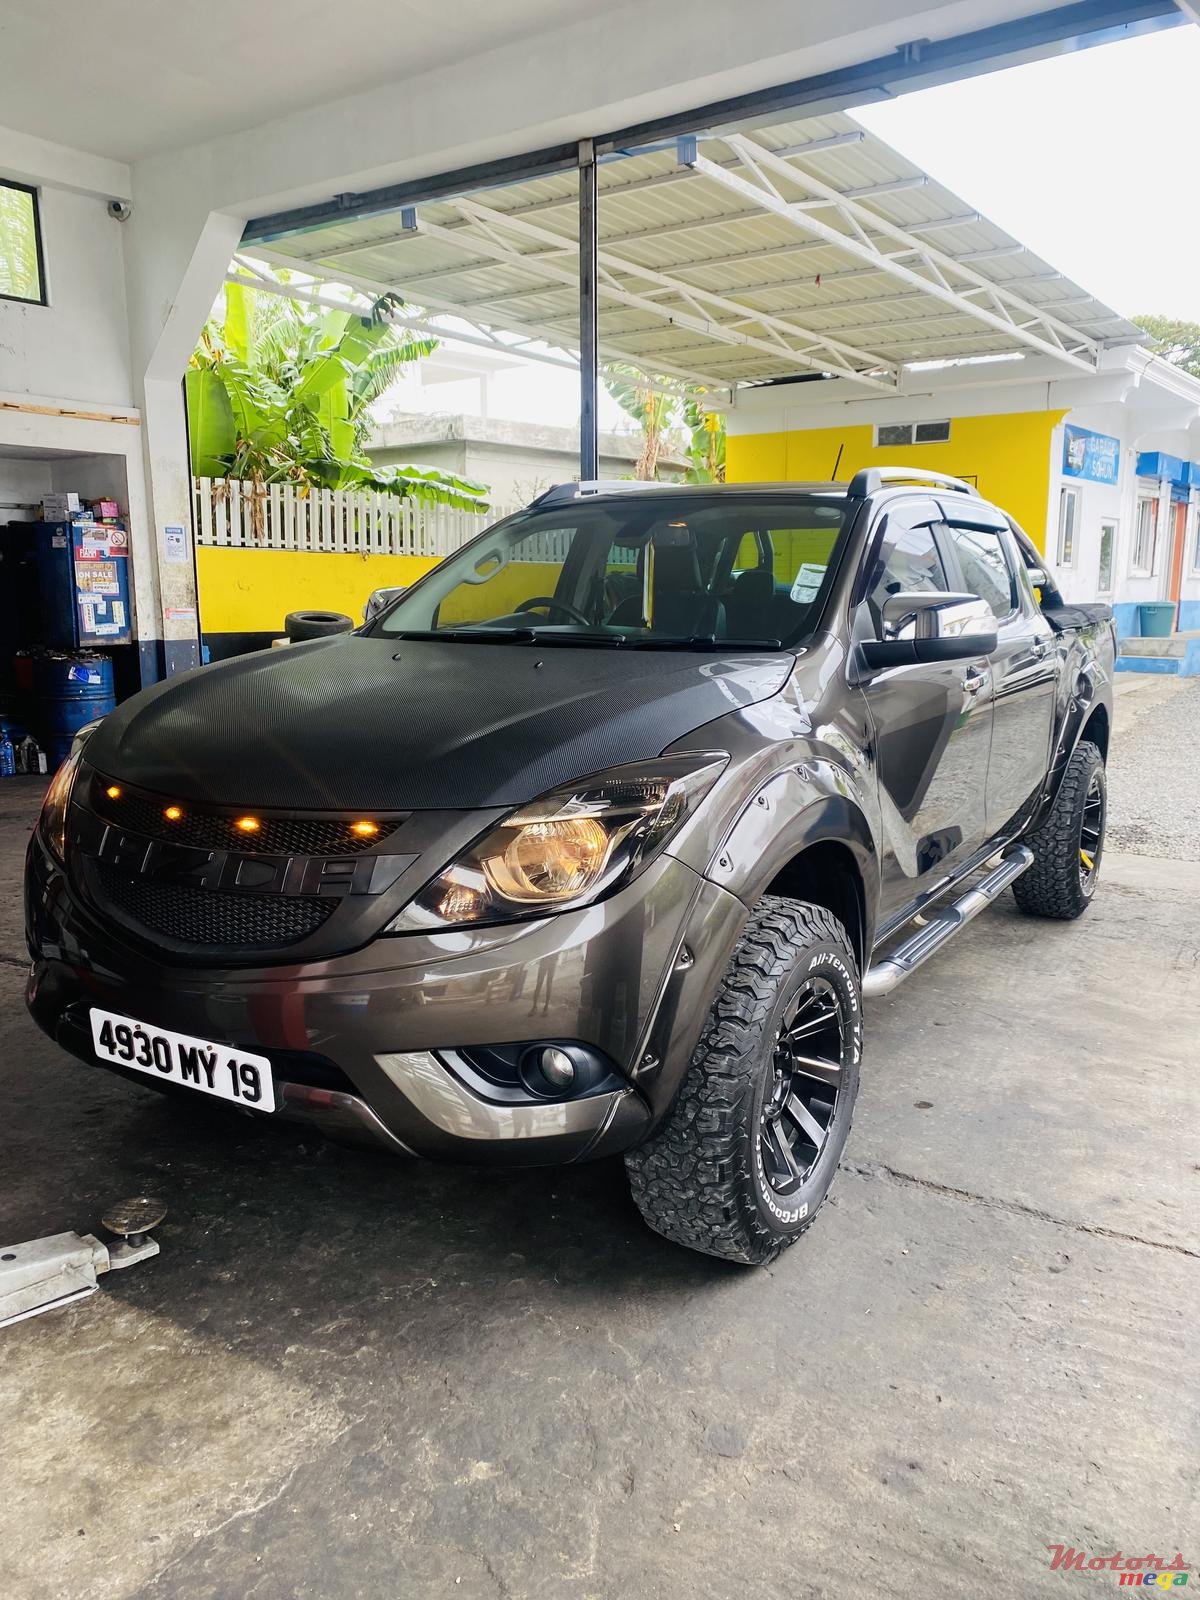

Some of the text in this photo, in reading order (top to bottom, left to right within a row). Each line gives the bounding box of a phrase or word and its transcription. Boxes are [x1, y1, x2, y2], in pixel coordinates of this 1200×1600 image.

[1092, 460, 1113, 480] SOHUN
[76, 815, 384, 896] AZDA
[100, 1020, 262, 1103] 4930 MY 19
